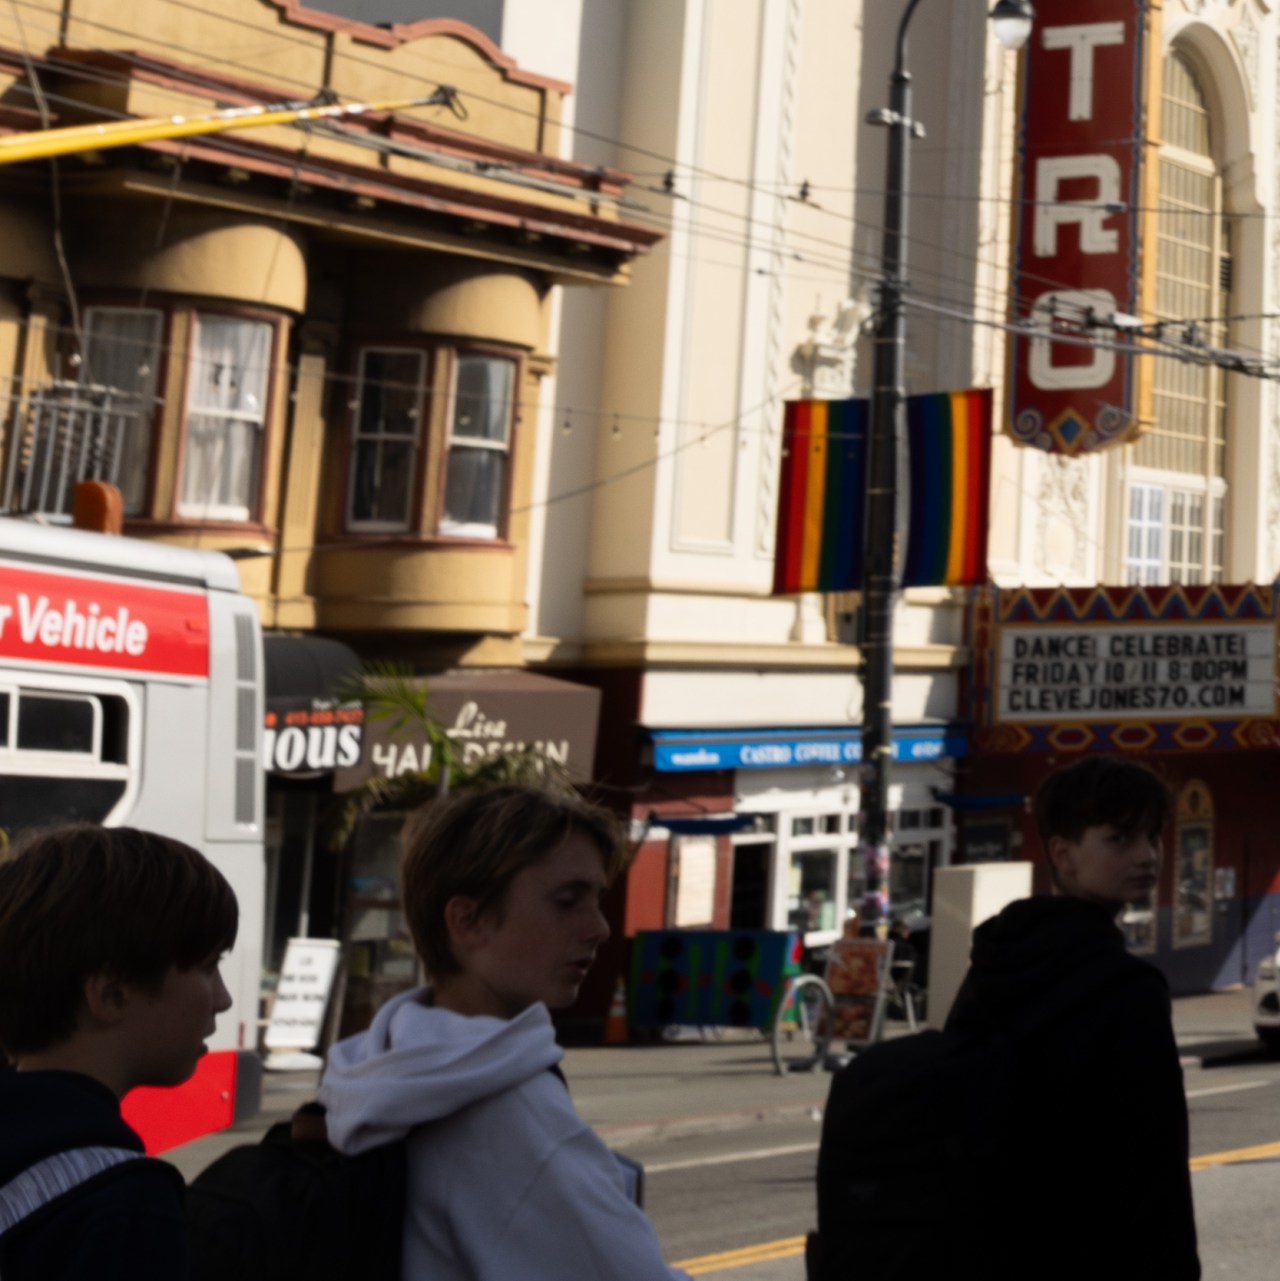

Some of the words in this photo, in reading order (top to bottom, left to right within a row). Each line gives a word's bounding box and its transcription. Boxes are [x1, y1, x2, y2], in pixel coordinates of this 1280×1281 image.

[17, 592, 149, 657] Vehicle
[1014, 636, 1098, 659] DANCE!
[1109, 634, 1247, 658] CELEBRATE!
[1011, 662, 1099, 685] FRIDAY
[1104, 661, 1158, 683] 10/11
[1167, 659, 1248, 682] 8:00PM
[1007, 686, 1247, 712] CLEVEJONES70.COM
